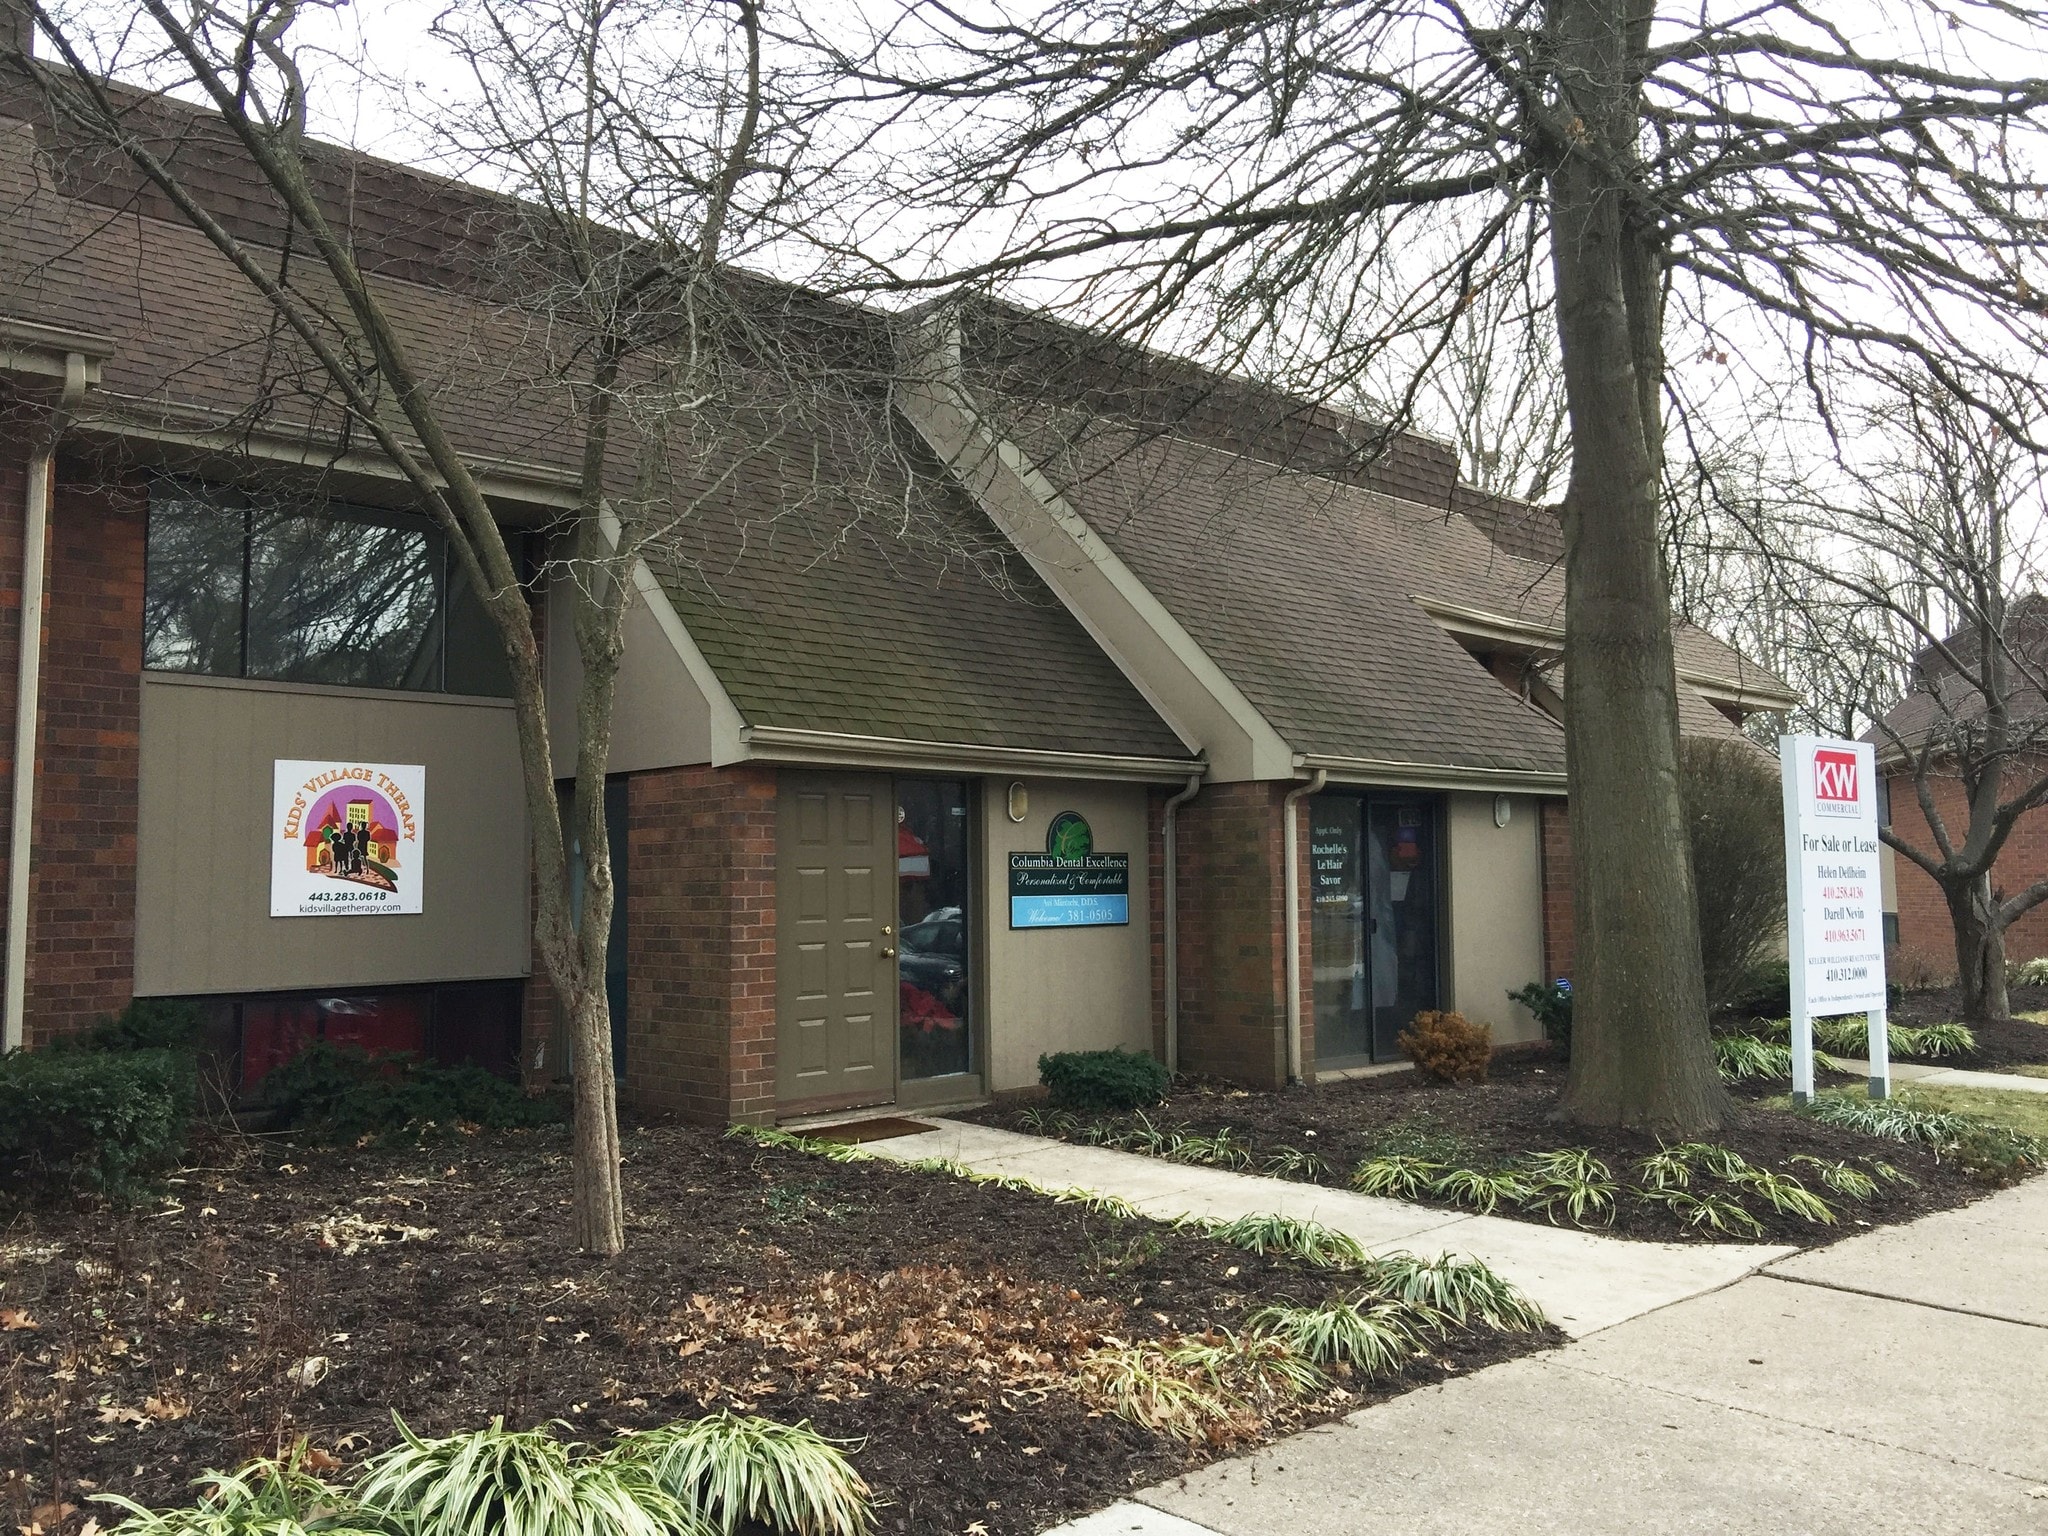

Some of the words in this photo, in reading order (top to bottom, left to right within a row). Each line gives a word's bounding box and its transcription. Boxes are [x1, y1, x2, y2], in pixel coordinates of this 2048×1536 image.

[1815, 761, 1856, 799] KW
[284, 792, 307, 840] KIDS'
[303, 767, 374, 793] VILLAGE
[377, 773, 416, 843] THERAPY
[1817, 802, 1859, 814] COMMERCIAL
[1312, 843, 1348, 855] Rochelle's
[1803, 834, 1819, 852] For
[1821, 834, 1840, 853] Sale
[1842, 840, 1852, 853] or
[1854, 835, 1877, 854] Lease
[1011, 856, 1054, 868] Columbia
[1056, 856, 1084, 868] Dental
[1086, 856, 1127, 868] Excellence
[1817, 865, 1837, 879] Helen
[1016, 871, 1070, 886] Personalized
[1076, 871, 1123, 889] Comfortable
[1320, 874, 1342, 885] Savor
[308, 892, 387, 902] 443.283.0618
[299, 903, 401, 914] kidsvillagetherapy.com
[1845, 906, 1865, 920] Nevin
[1067, 909, 1113, 922] 381-0505
[1808, 957, 1827, 965] KELLER
[1827, 955, 1849, 964] WILLIAMS
[1849, 954, 1865, 963] REALTY
[1826, 966, 1868, 982] 410.312.0000
